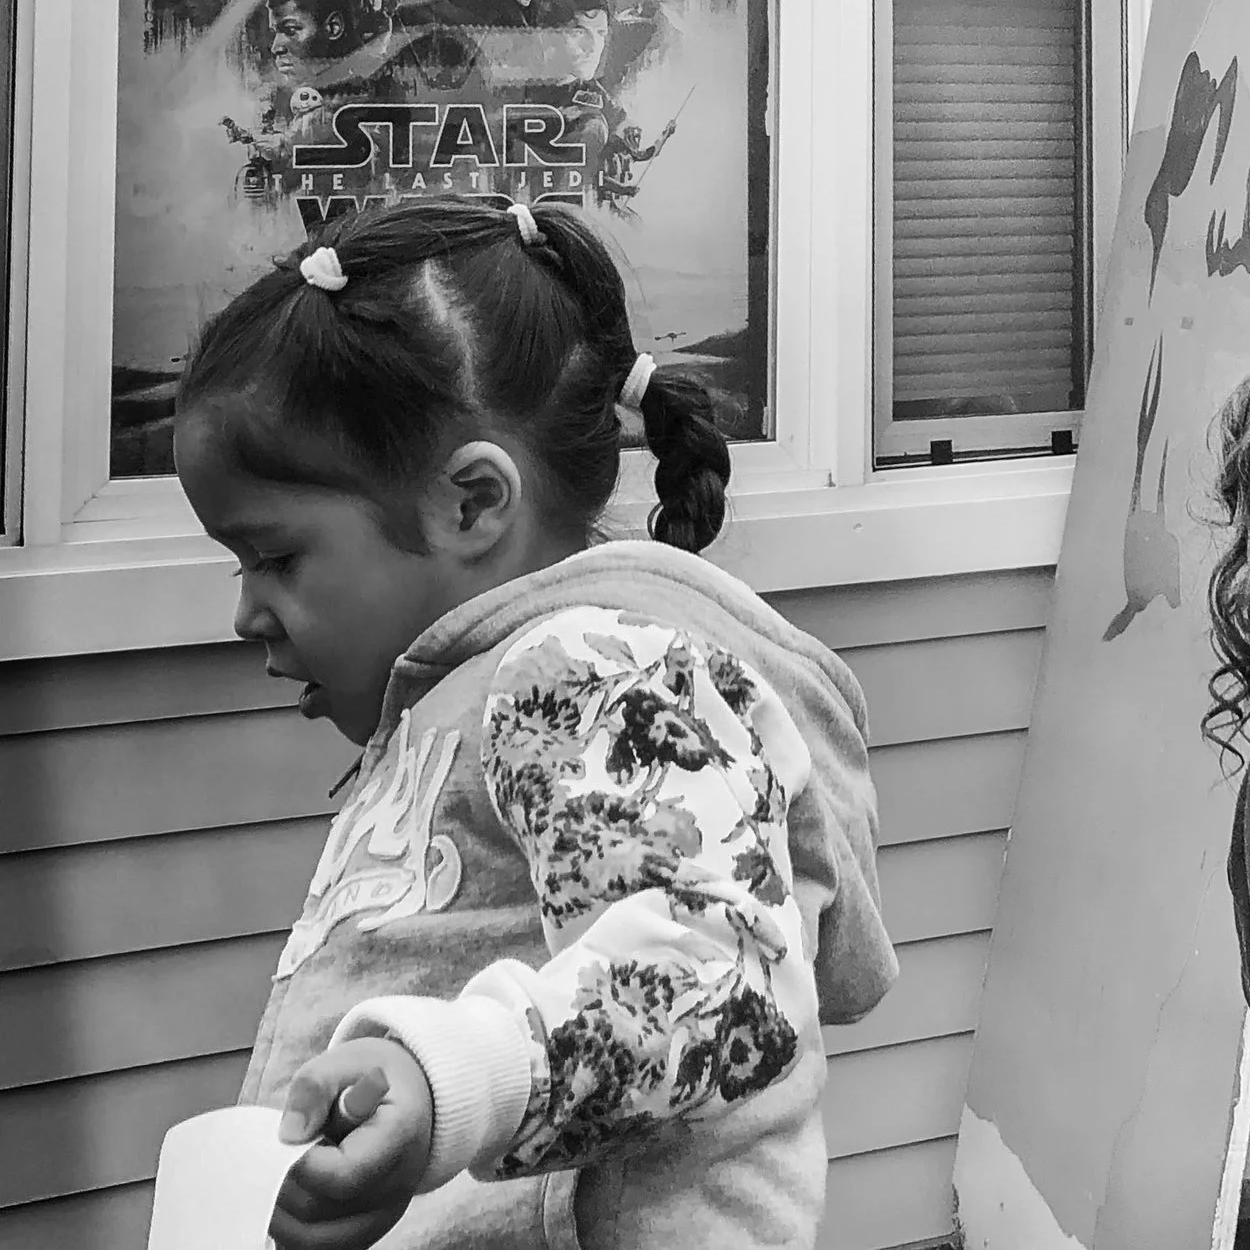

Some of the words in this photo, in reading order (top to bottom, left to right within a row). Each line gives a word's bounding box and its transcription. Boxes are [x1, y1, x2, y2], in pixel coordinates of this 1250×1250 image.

[292, 103, 586, 169] STAR
[272, 173, 344, 192] THE
[384, 171, 480, 190] LAST
[518, 170, 605, 189] JEDI
